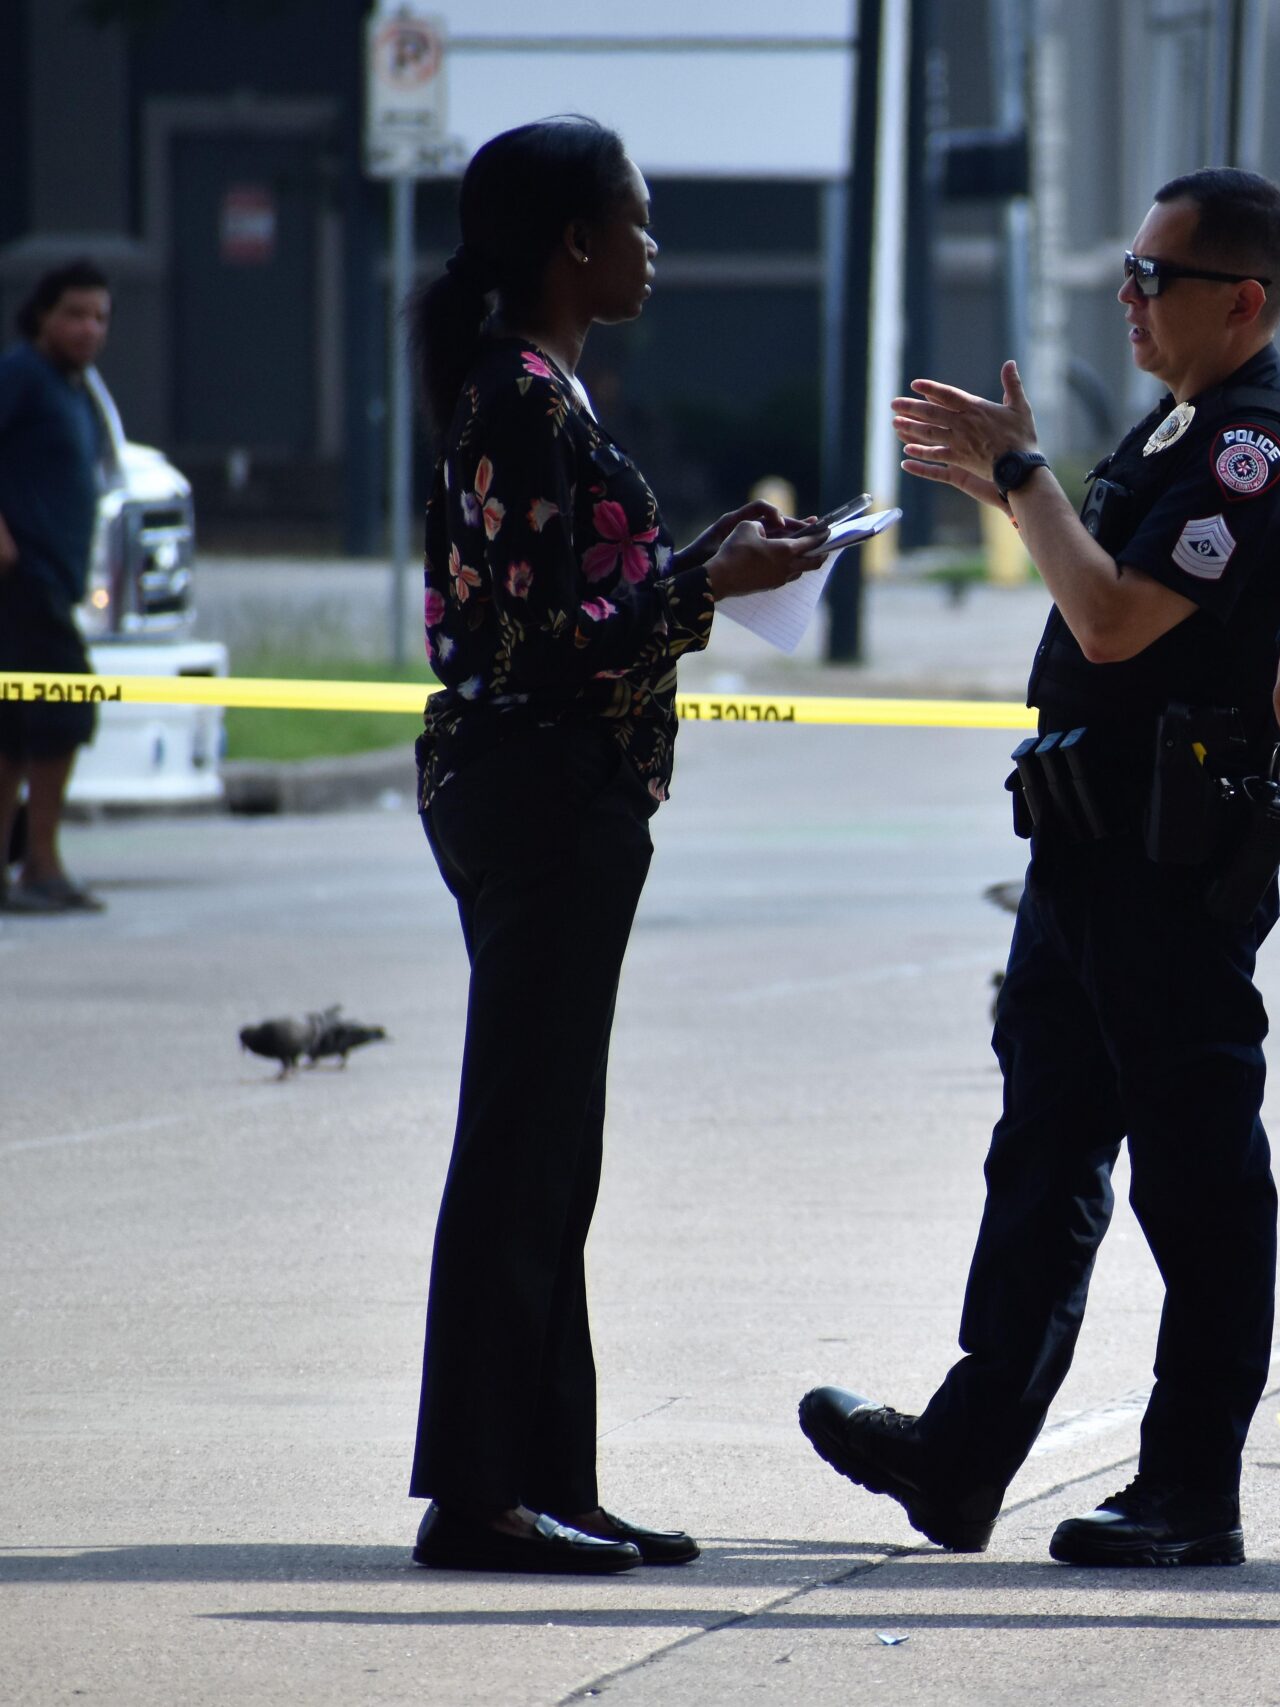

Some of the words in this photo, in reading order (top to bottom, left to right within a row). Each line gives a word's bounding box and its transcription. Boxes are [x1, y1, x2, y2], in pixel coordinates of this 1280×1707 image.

[0, 682, 23, 701] LI
[33, 683, 121, 702] POLICE
[677, 702, 700, 720] LI
[710, 703, 795, 721] POLICE
